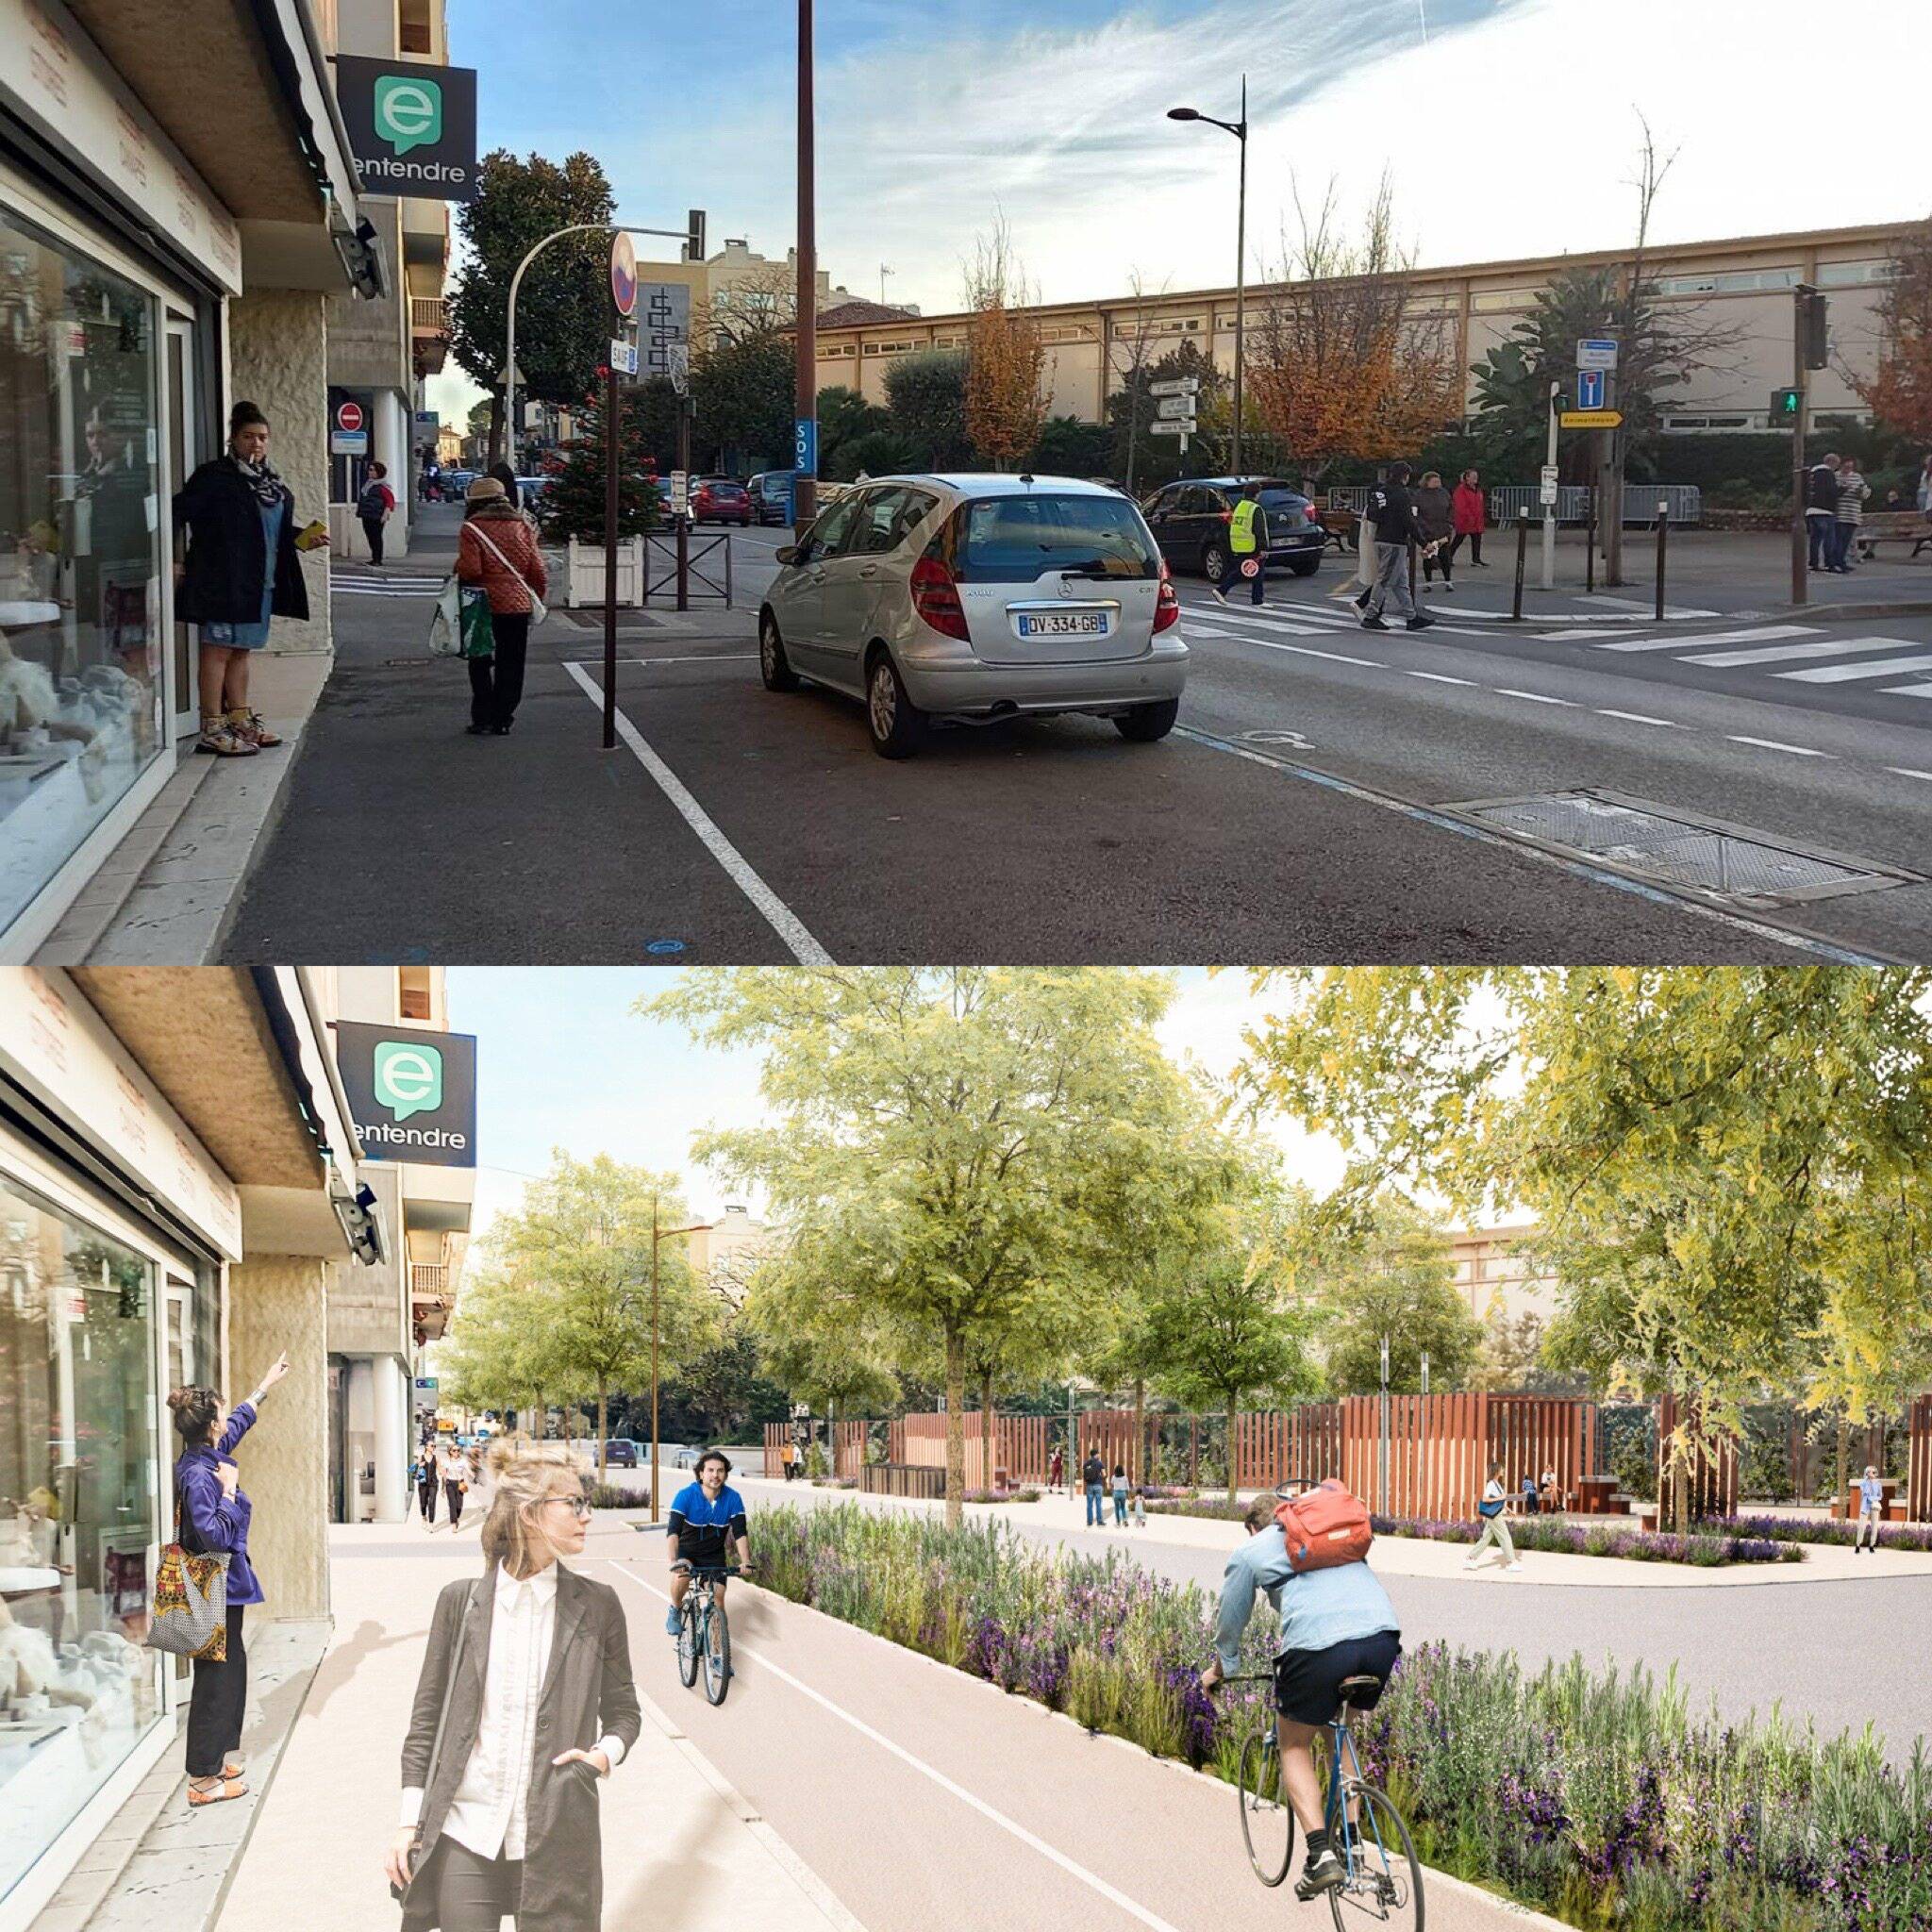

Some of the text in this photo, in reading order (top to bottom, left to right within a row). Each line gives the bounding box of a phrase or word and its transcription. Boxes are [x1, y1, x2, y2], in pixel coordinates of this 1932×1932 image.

[383, 86, 434, 135] e
[354, 157, 465, 183] entendre
[797, 425, 807, 469] SOS
[1029, 616, 1098, 633] DV-334-GB
[383, 1052, 434, 1101] e
[354, 1123, 466, 1149] entendre
